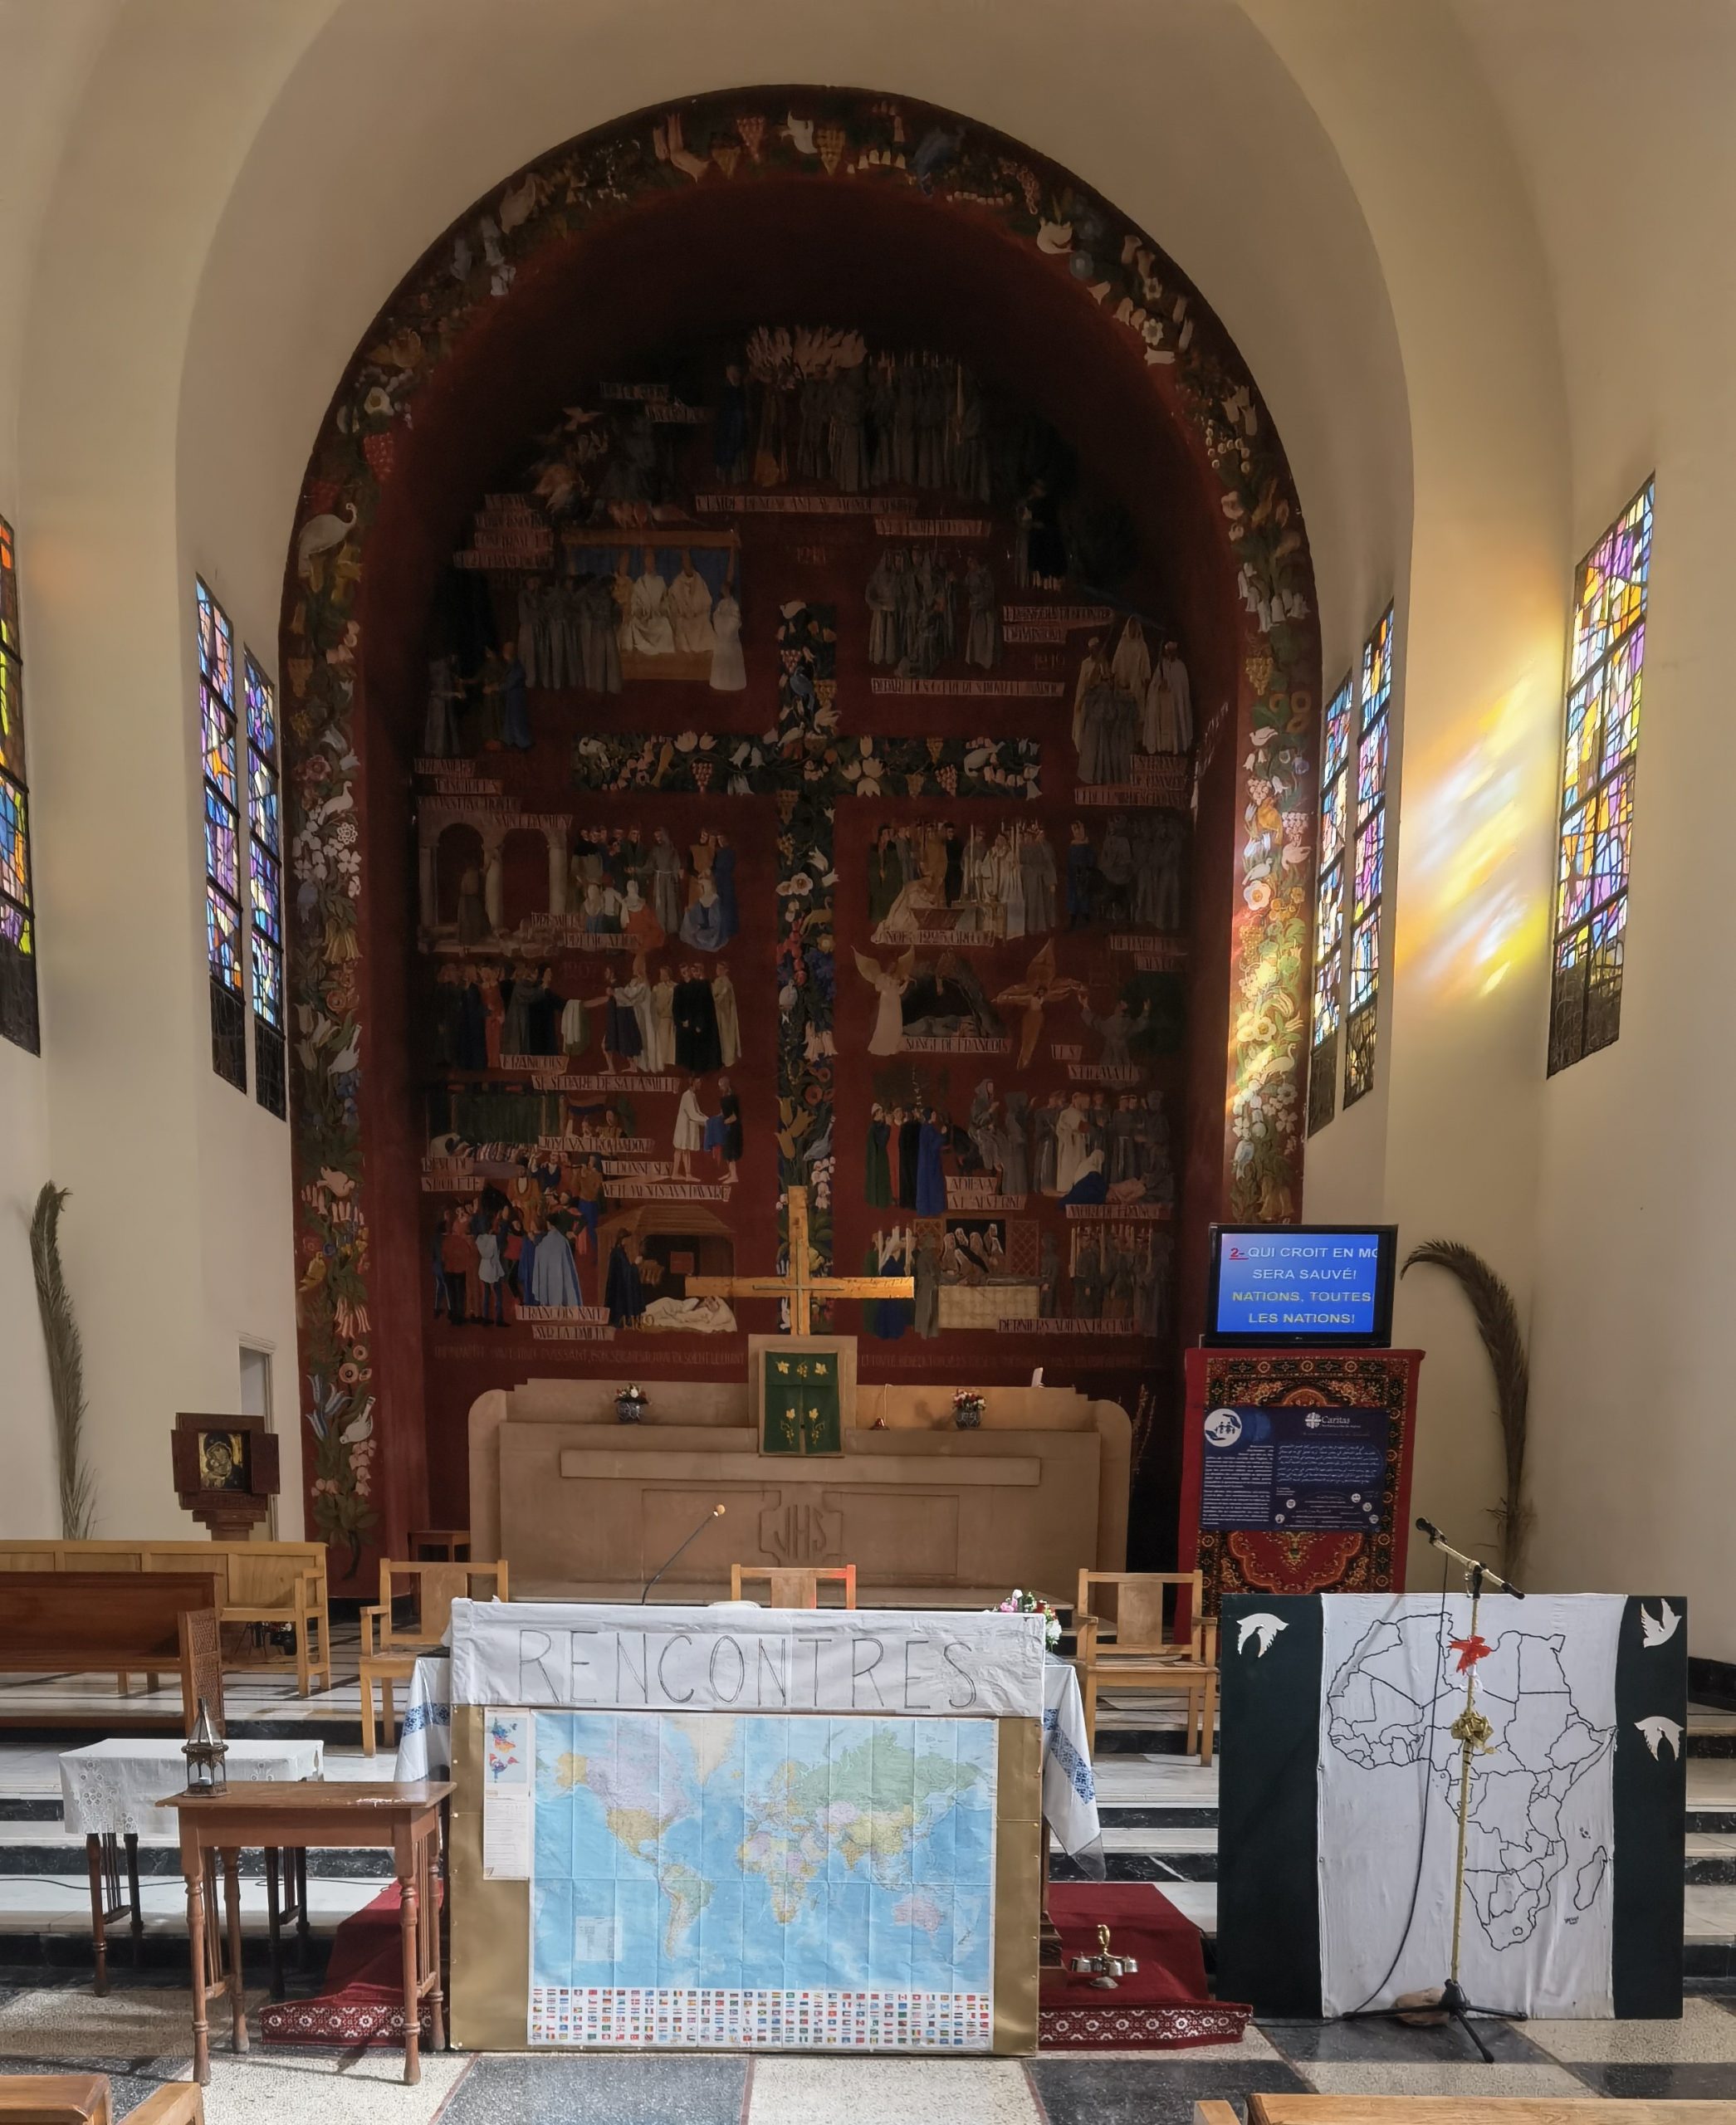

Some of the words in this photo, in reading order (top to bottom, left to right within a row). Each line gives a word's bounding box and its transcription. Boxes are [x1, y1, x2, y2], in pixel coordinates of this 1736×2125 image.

[1248, 1247, 1275, 1258] QUI
[1280, 1247, 1328, 1258] CROIT
[1333, 1248, 1353, 1258] EN
[1252, 1269, 1295, 1279] SERA
[1299, 1268, 1357, 1280] SAUVÉ!
[1309, 1292, 1372, 1302] TOUTES
[1248, 1313, 1279, 1323] LES
[1283, 1313, 1355, 1324] NATIONS!
[1321, 1416, 1351, 1424] Caritas
[518, 1629, 977, 1709] RENCONTRES
